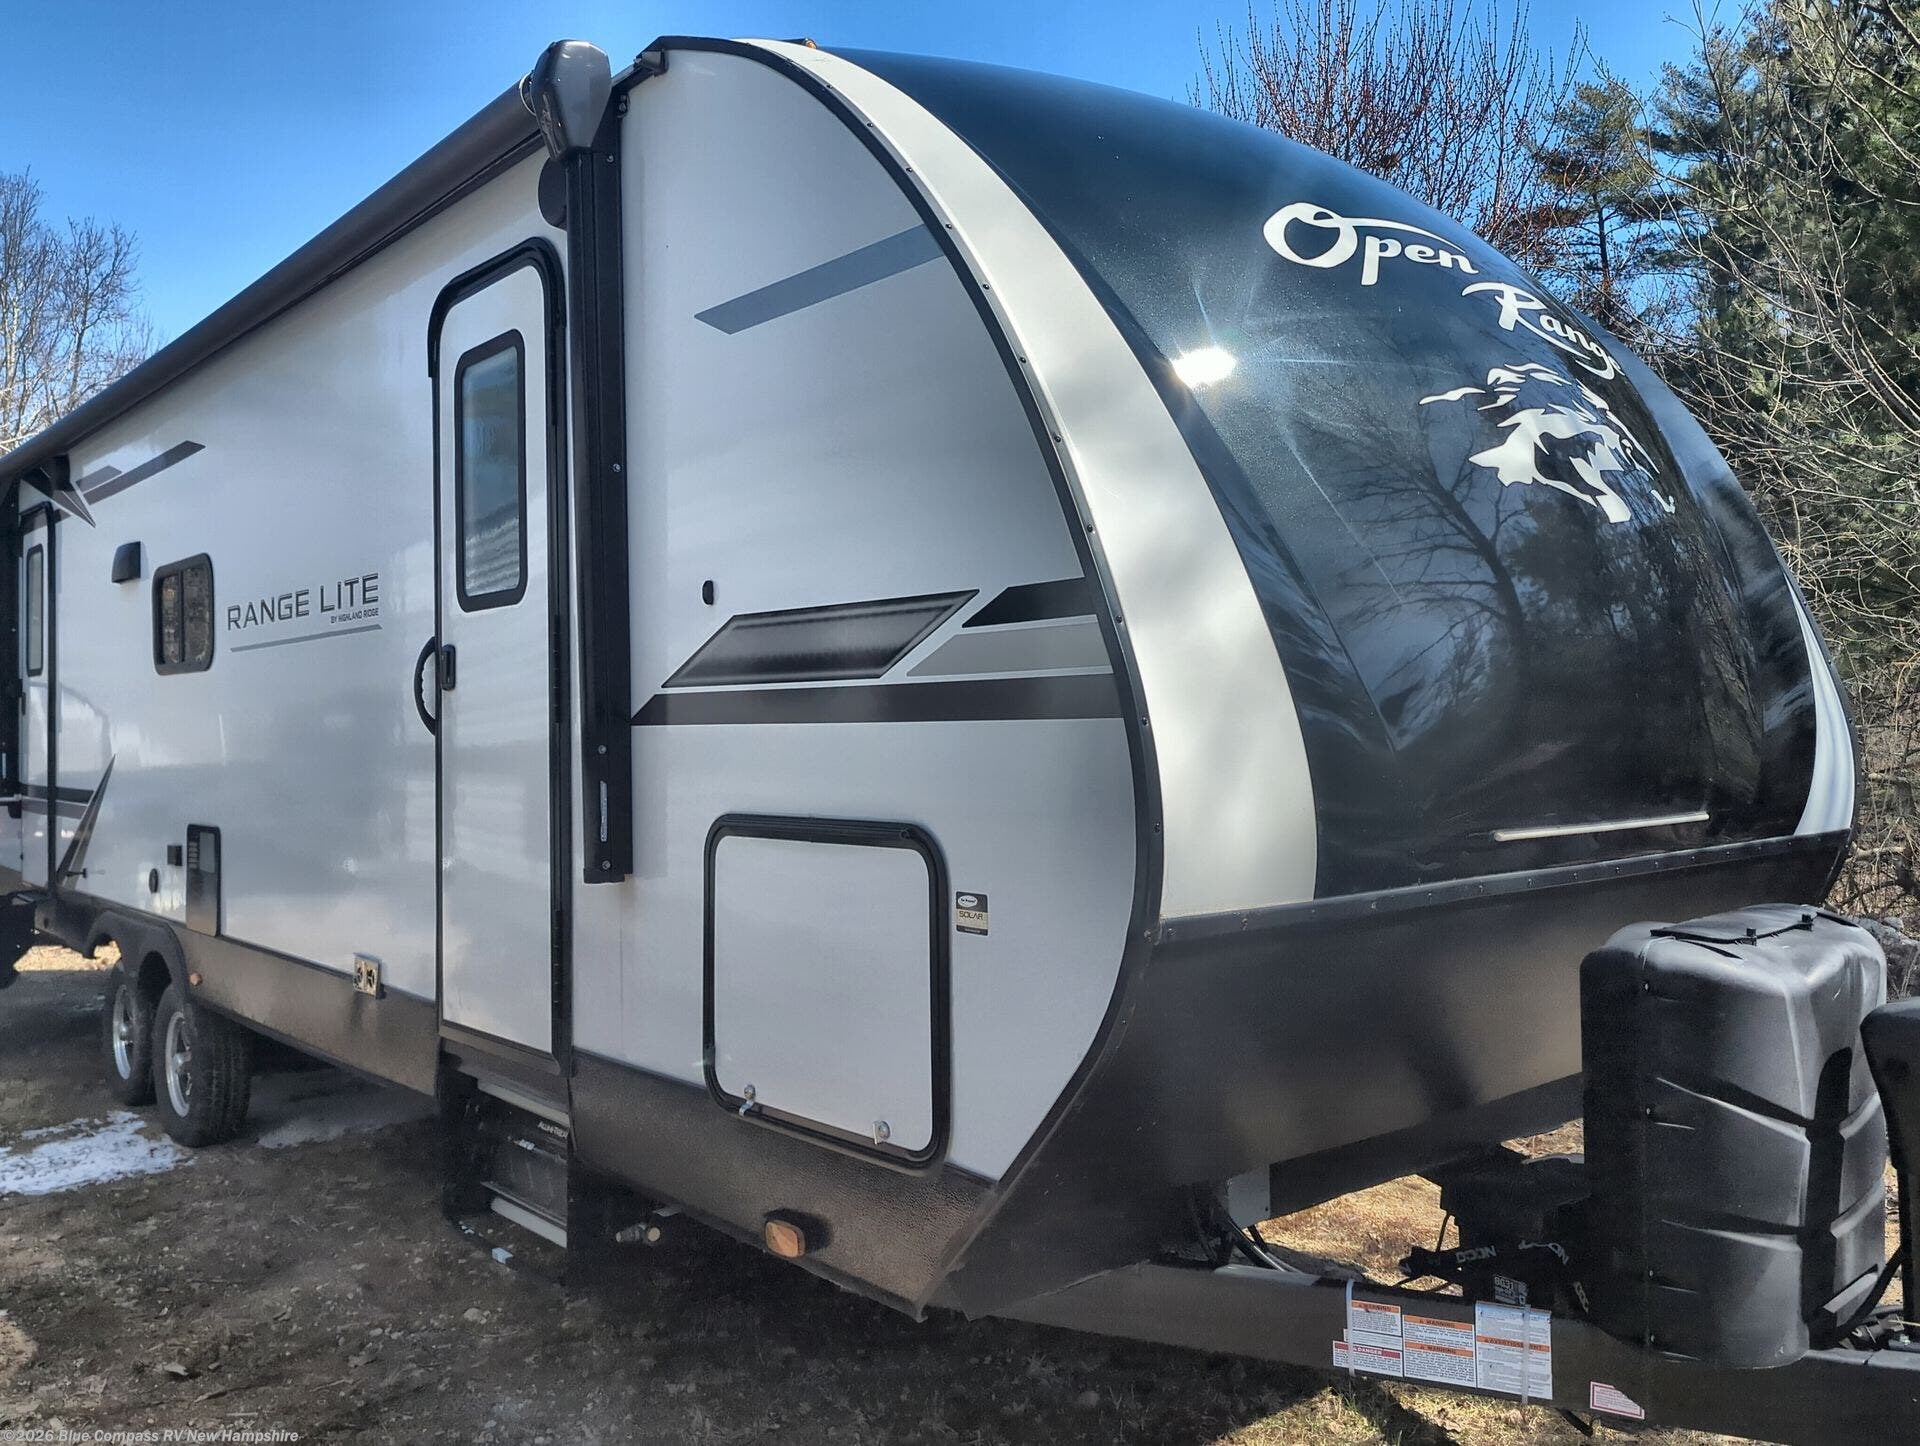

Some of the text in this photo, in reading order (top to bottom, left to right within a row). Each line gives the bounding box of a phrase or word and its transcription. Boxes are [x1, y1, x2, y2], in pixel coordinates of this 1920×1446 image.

[1263, 202, 1478, 286] Open
[227, 572, 379, 631] RANGE LITE
[331, 607, 379, 624] BY HIGHLAND RIDGE
[959, 910, 983, 920] SOLAR
[1427, 1320, 1455, 1328] WARNING
[1357, 1347, 1382, 1355] DANGER
[1427, 1345, 1456, 1354] WARNING
